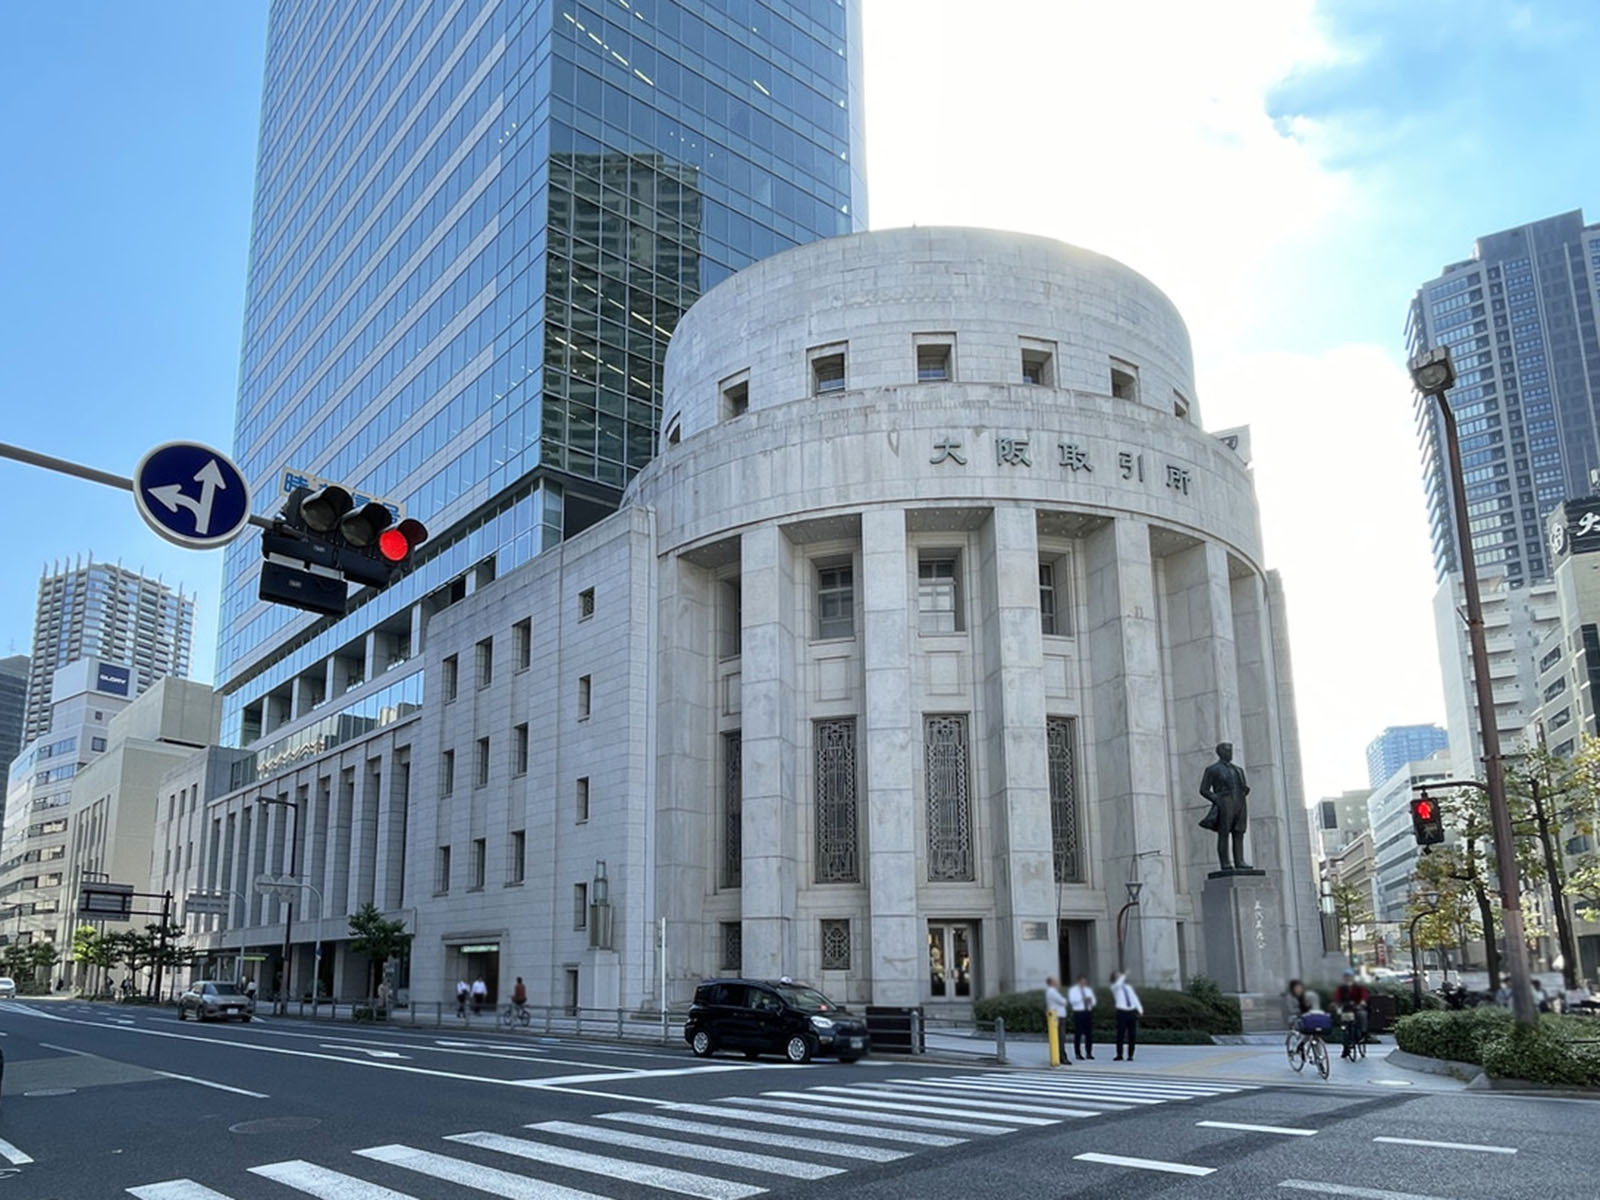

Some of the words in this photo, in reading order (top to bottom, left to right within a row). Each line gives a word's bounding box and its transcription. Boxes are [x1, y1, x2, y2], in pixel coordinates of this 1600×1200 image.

[929, 437, 1192, 496] 大阪取引所
